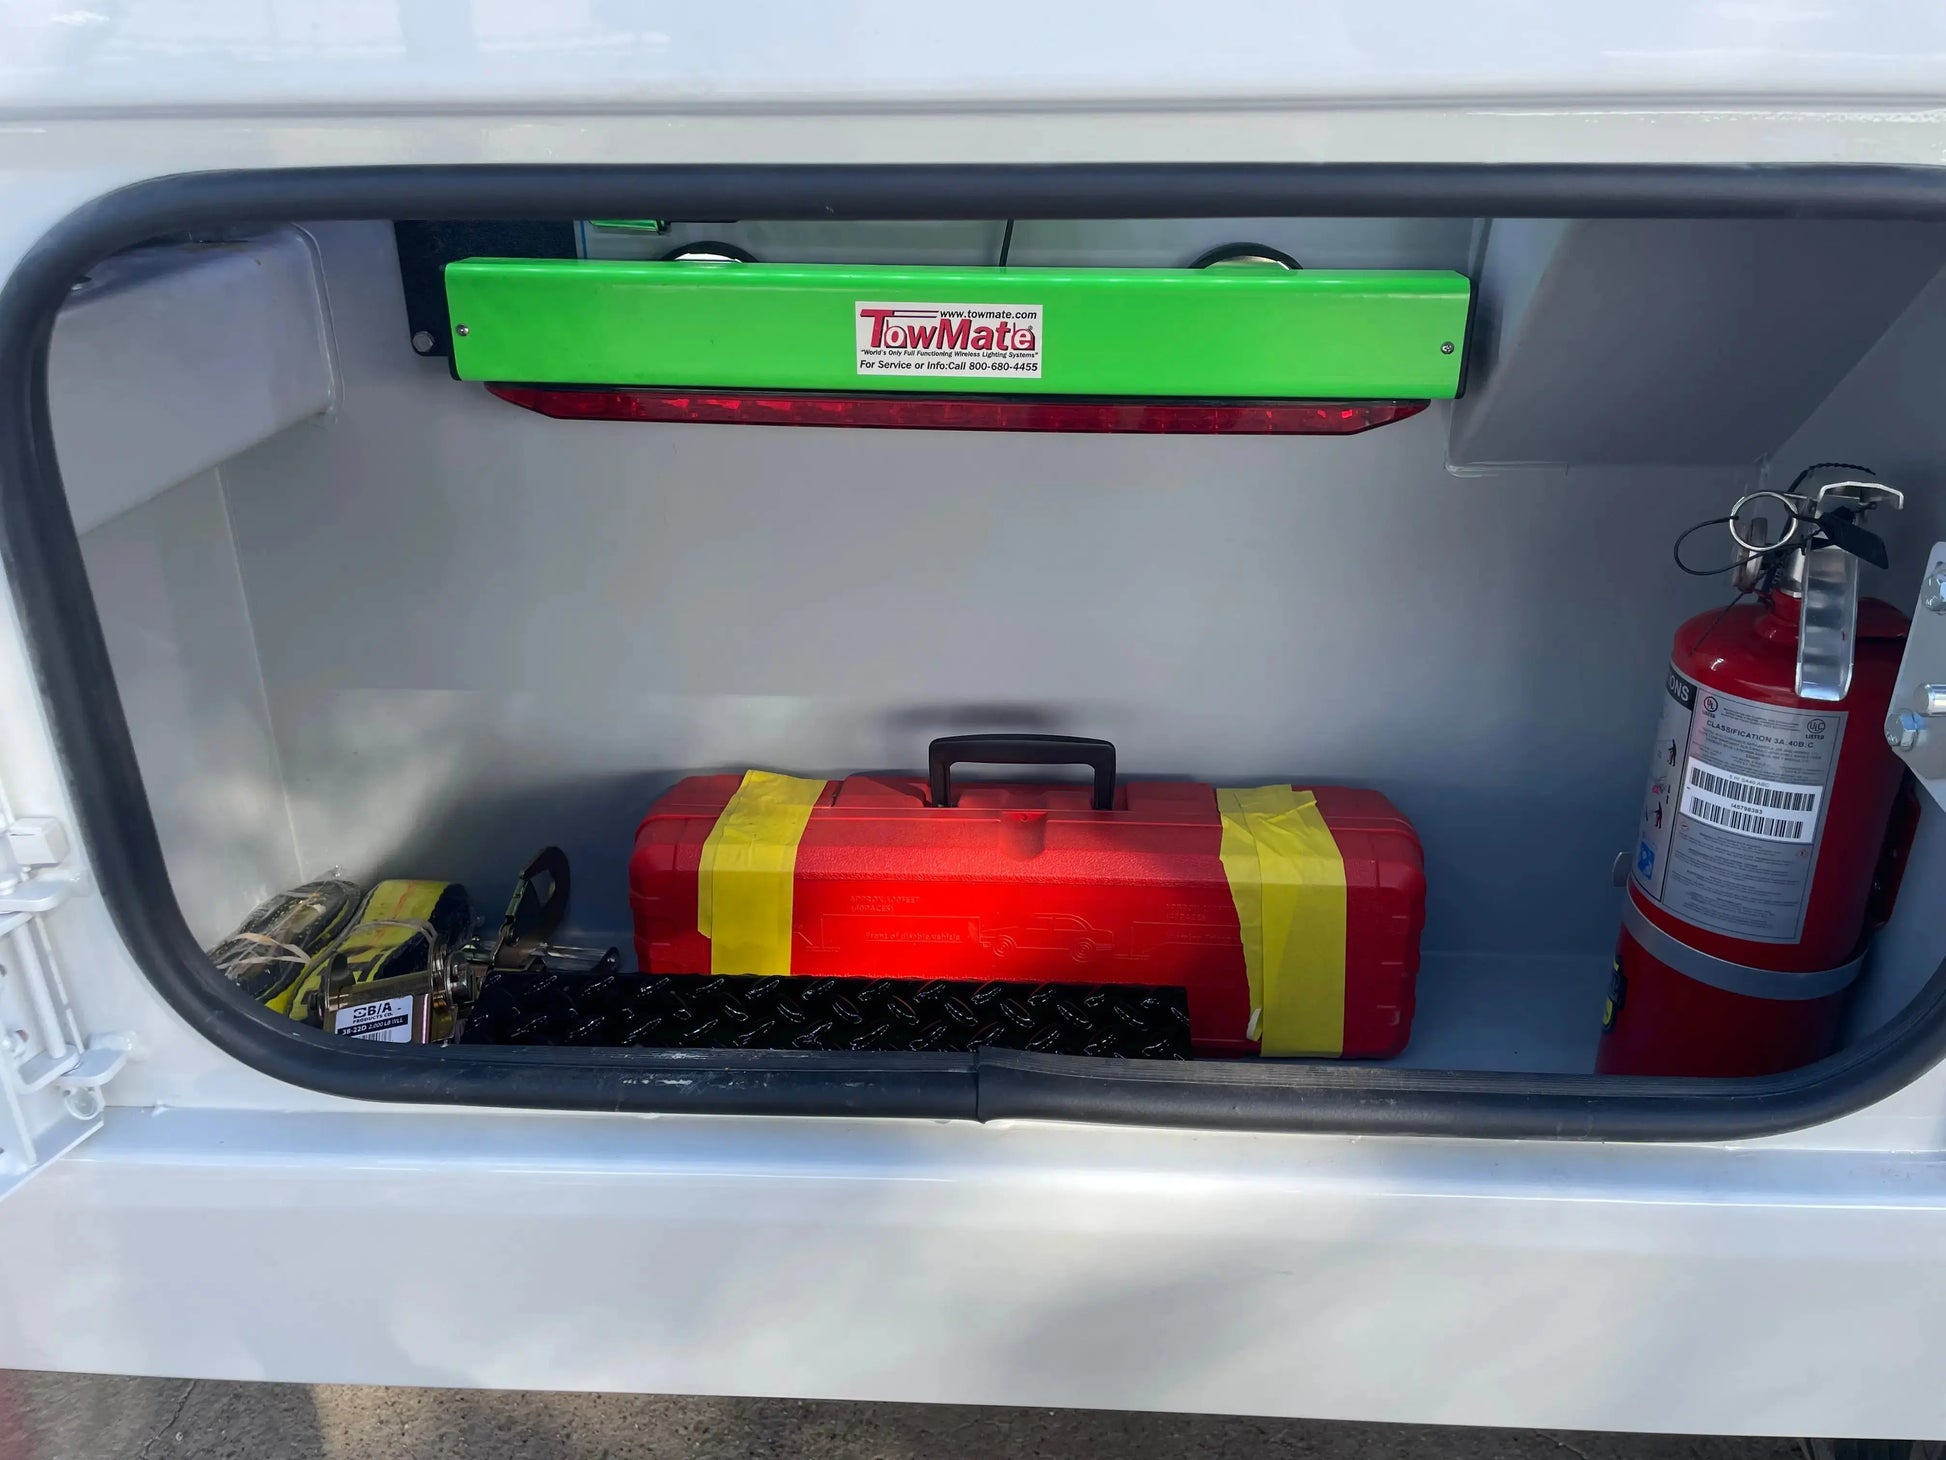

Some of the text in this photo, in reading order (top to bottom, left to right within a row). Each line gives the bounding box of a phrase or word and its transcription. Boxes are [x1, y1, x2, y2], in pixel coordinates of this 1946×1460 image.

[940, 309, 1037, 320] www.towmate.com
[888, 349, 902, 357] Only
[916, 350, 953, 358] Functioning
[860, 359, 875, 369] For
[878, 360, 912, 369] Service
[914, 362, 924, 370] or
[968, 361, 1038, 371] 800-680-4455
[1706, 719, 1772, 743] CLASSIFICATION
[367, 1002, 392, 1016] B/A
[352, 1014, 382, 1024] PRODUCTS
